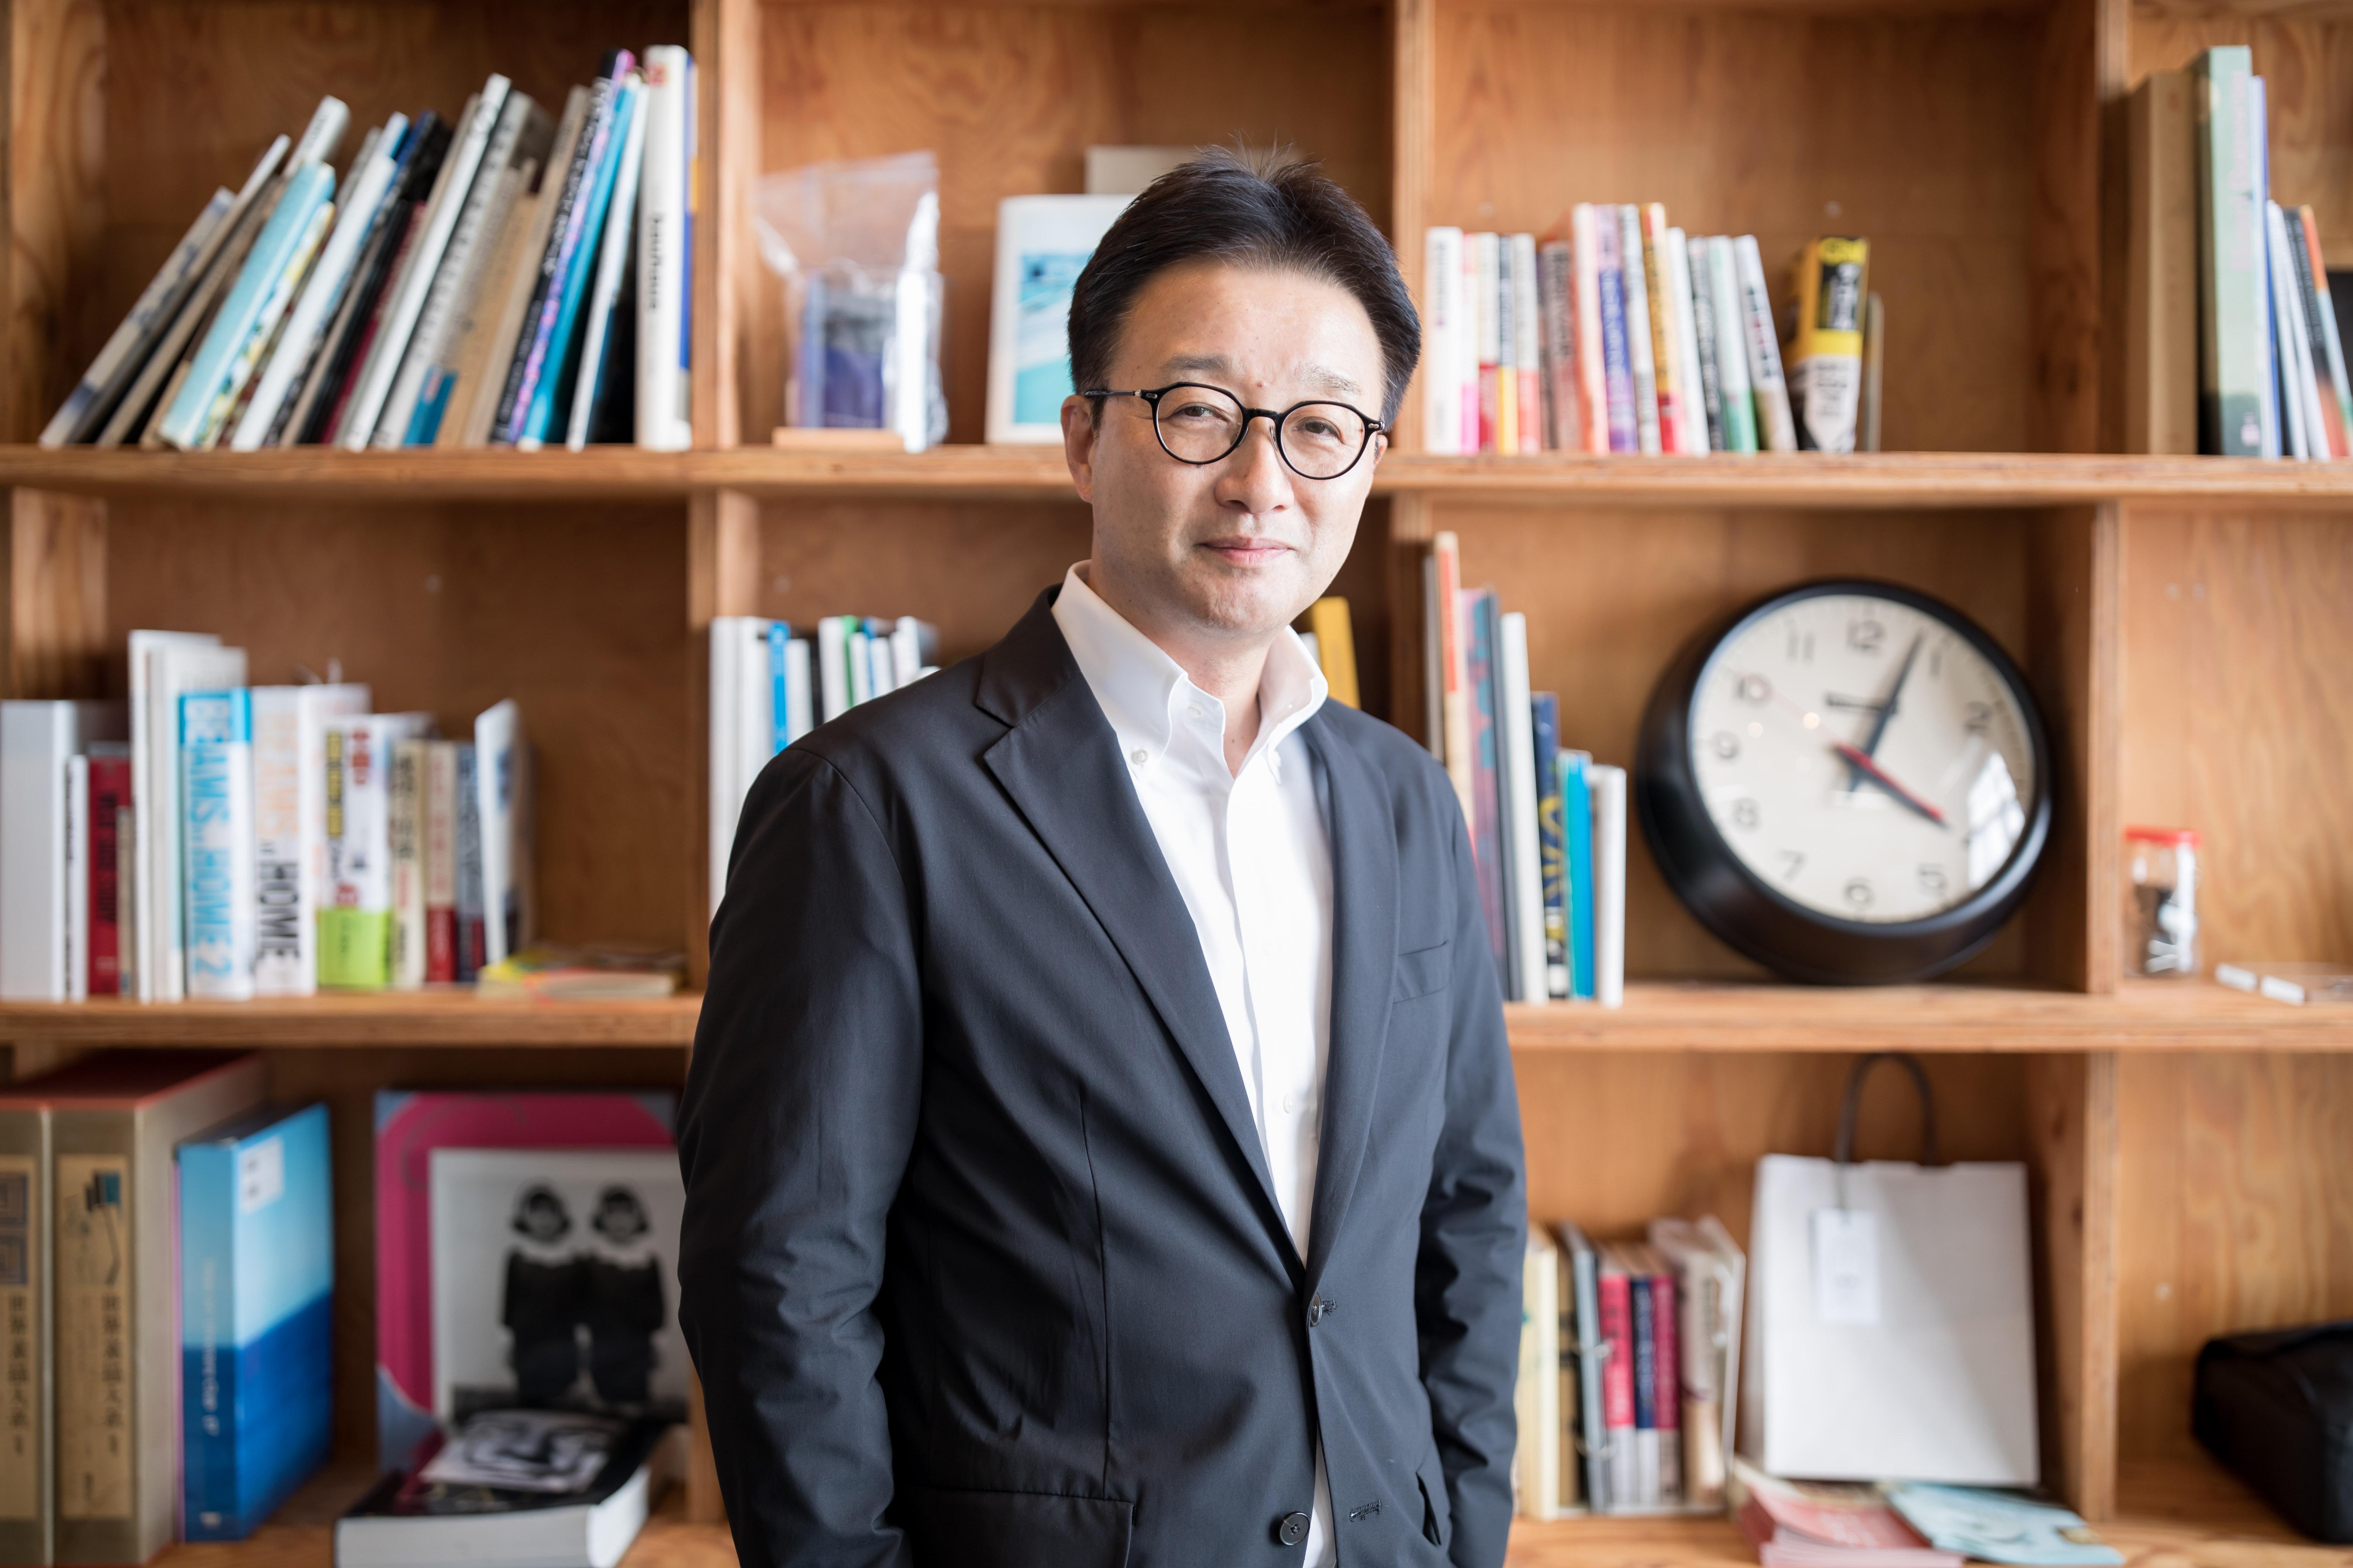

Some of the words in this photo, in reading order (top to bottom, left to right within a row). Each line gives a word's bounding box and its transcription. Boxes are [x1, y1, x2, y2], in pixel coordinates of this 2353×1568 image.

[1787, 629, 1815, 662] 11
[1849, 620, 1885, 654] 12
[1735, 674, 1773, 705] 10
[1713, 732, 1741, 761] 9
[1778, 850, 1805, 881] 7
[1845, 877, 1873, 907] 6
[259, 860, 300, 959] HOME
